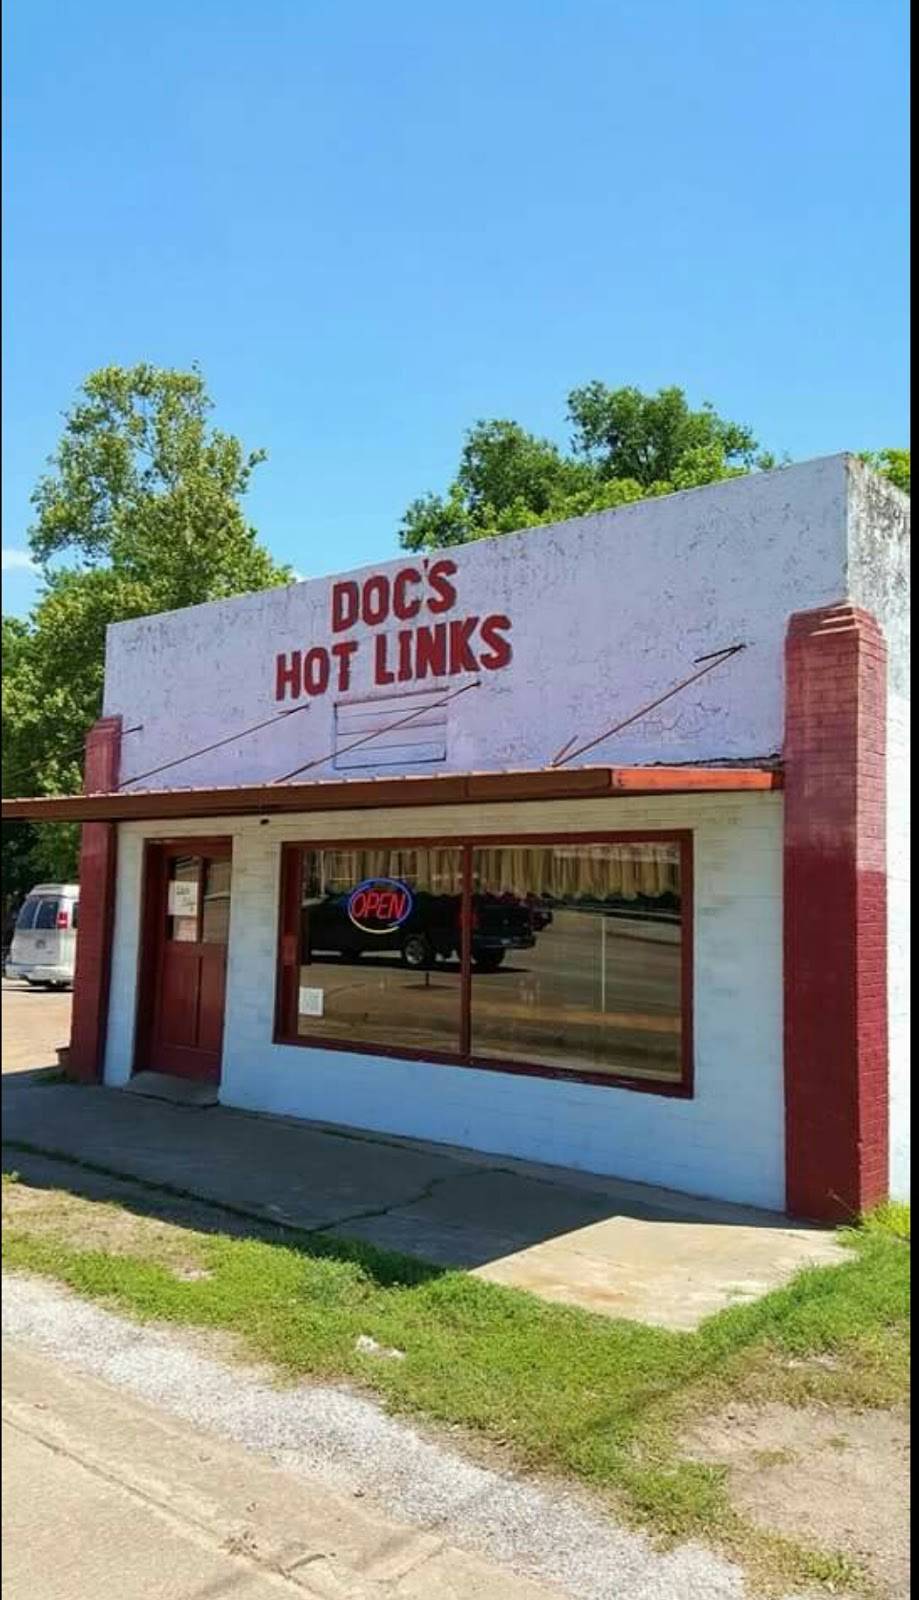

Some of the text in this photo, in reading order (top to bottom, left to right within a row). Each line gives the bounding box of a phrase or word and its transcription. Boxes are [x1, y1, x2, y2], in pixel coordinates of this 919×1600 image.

[332, 559, 457, 633] DOC'S
[275, 614, 513, 701] HOT LINKS
[351, 892, 406, 919] OPEN
